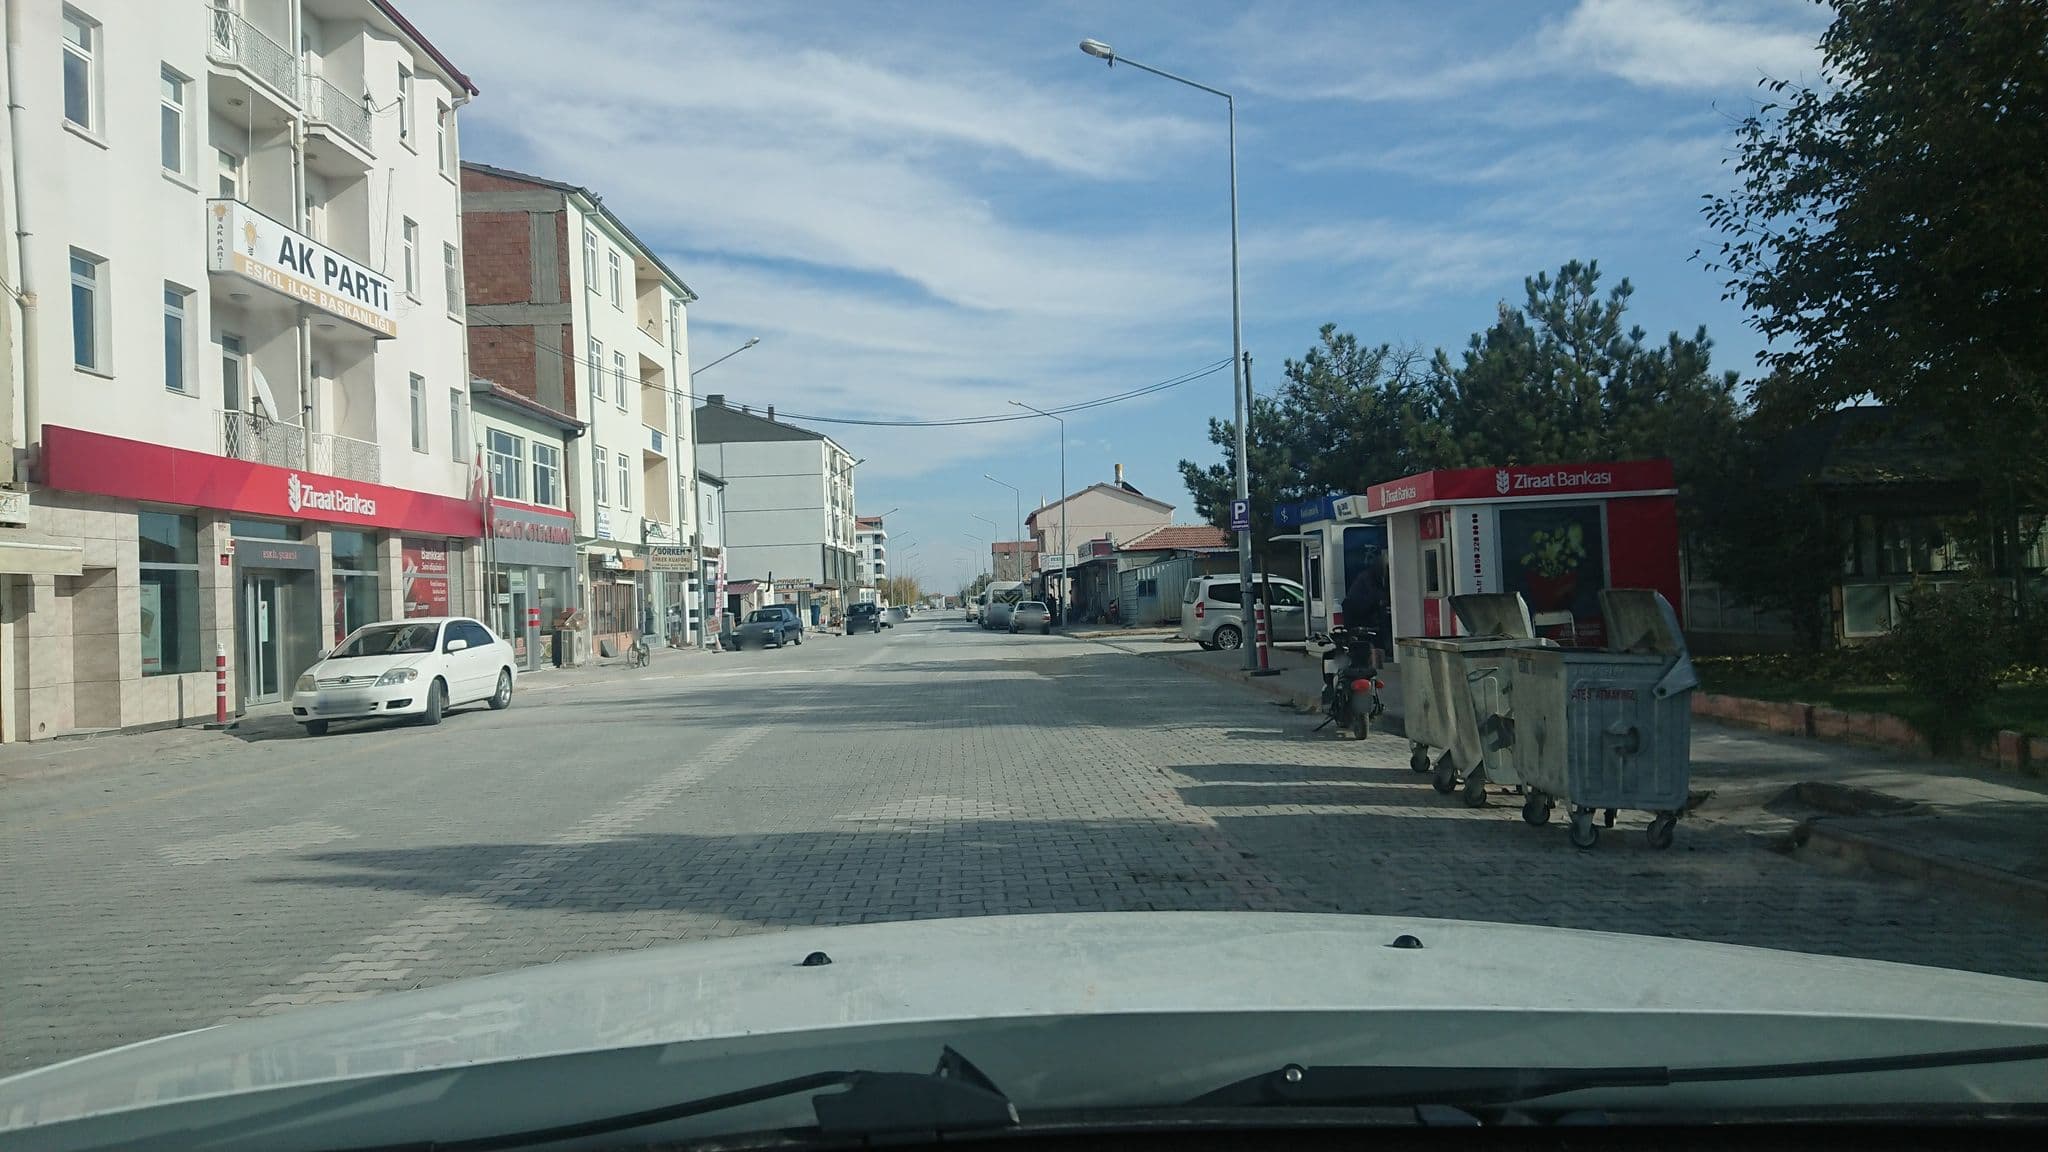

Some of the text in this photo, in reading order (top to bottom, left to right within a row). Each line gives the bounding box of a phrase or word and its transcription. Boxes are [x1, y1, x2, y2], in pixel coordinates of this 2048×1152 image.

[278, 235, 316, 279] AK
[1513, 470, 1612, 489] Ziraat Bankası
[301, 484, 376, 516] Ziraat Bankası
[1235, 503, 1246, 519] P
